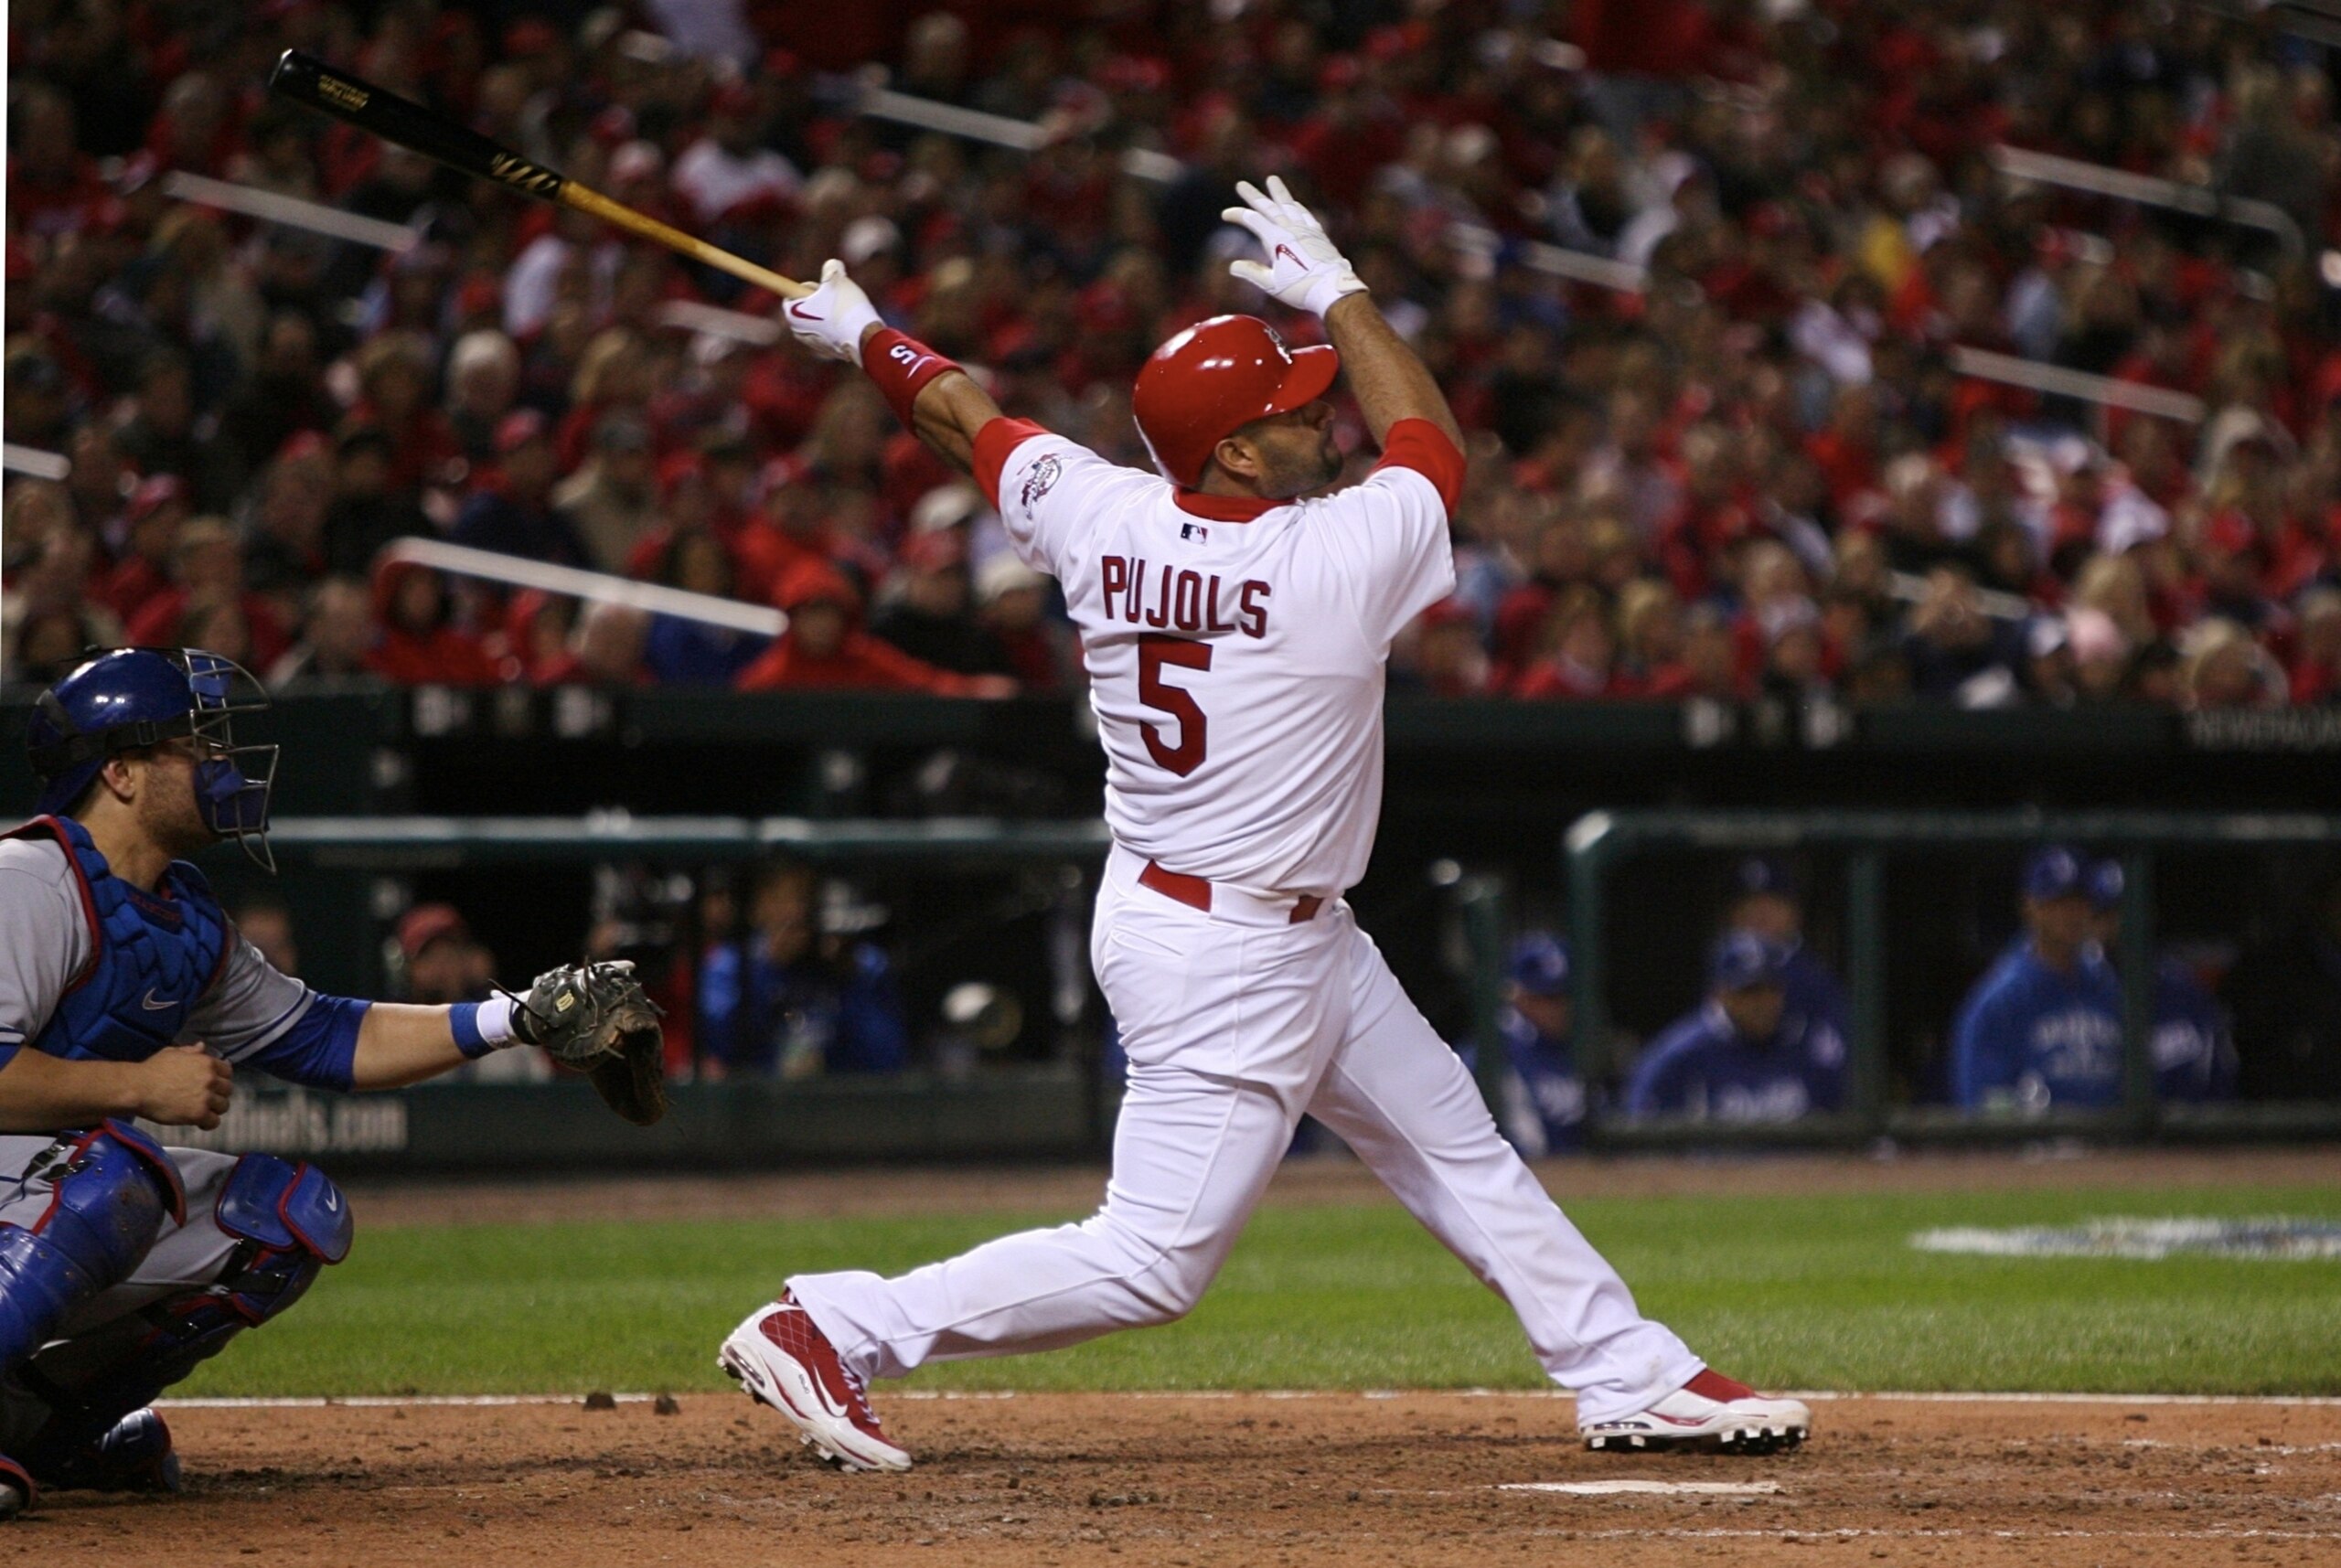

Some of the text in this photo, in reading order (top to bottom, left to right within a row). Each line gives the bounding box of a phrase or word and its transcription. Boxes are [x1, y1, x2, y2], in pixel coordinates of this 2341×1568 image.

[890, 345, 918, 365] 5
[1101, 555, 1271, 639] PUJOLS
[1138, 632, 1213, 778] 5
